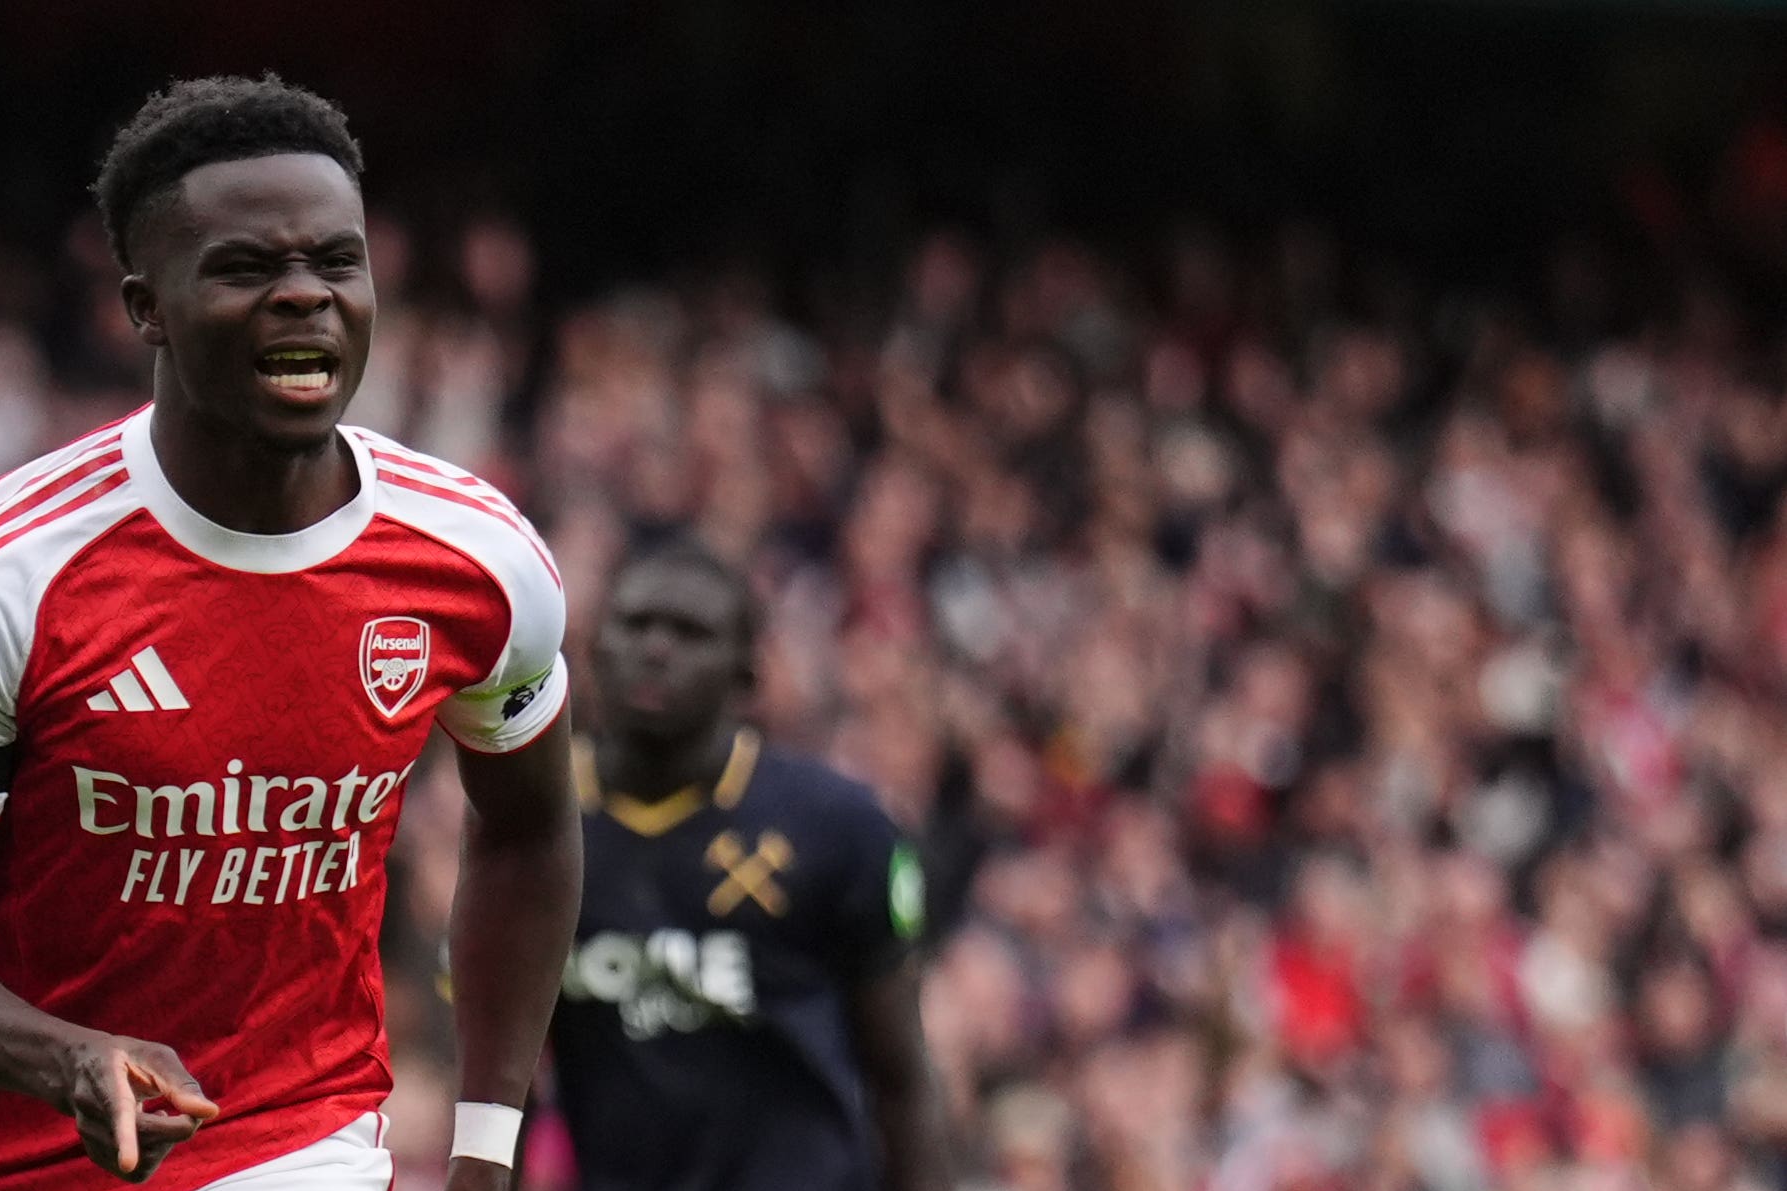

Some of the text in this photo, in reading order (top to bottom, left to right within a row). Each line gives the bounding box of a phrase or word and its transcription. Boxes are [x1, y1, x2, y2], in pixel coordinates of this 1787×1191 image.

[372, 634, 420, 650] Arsenal
[119, 830, 361, 906] FLY BETTER
